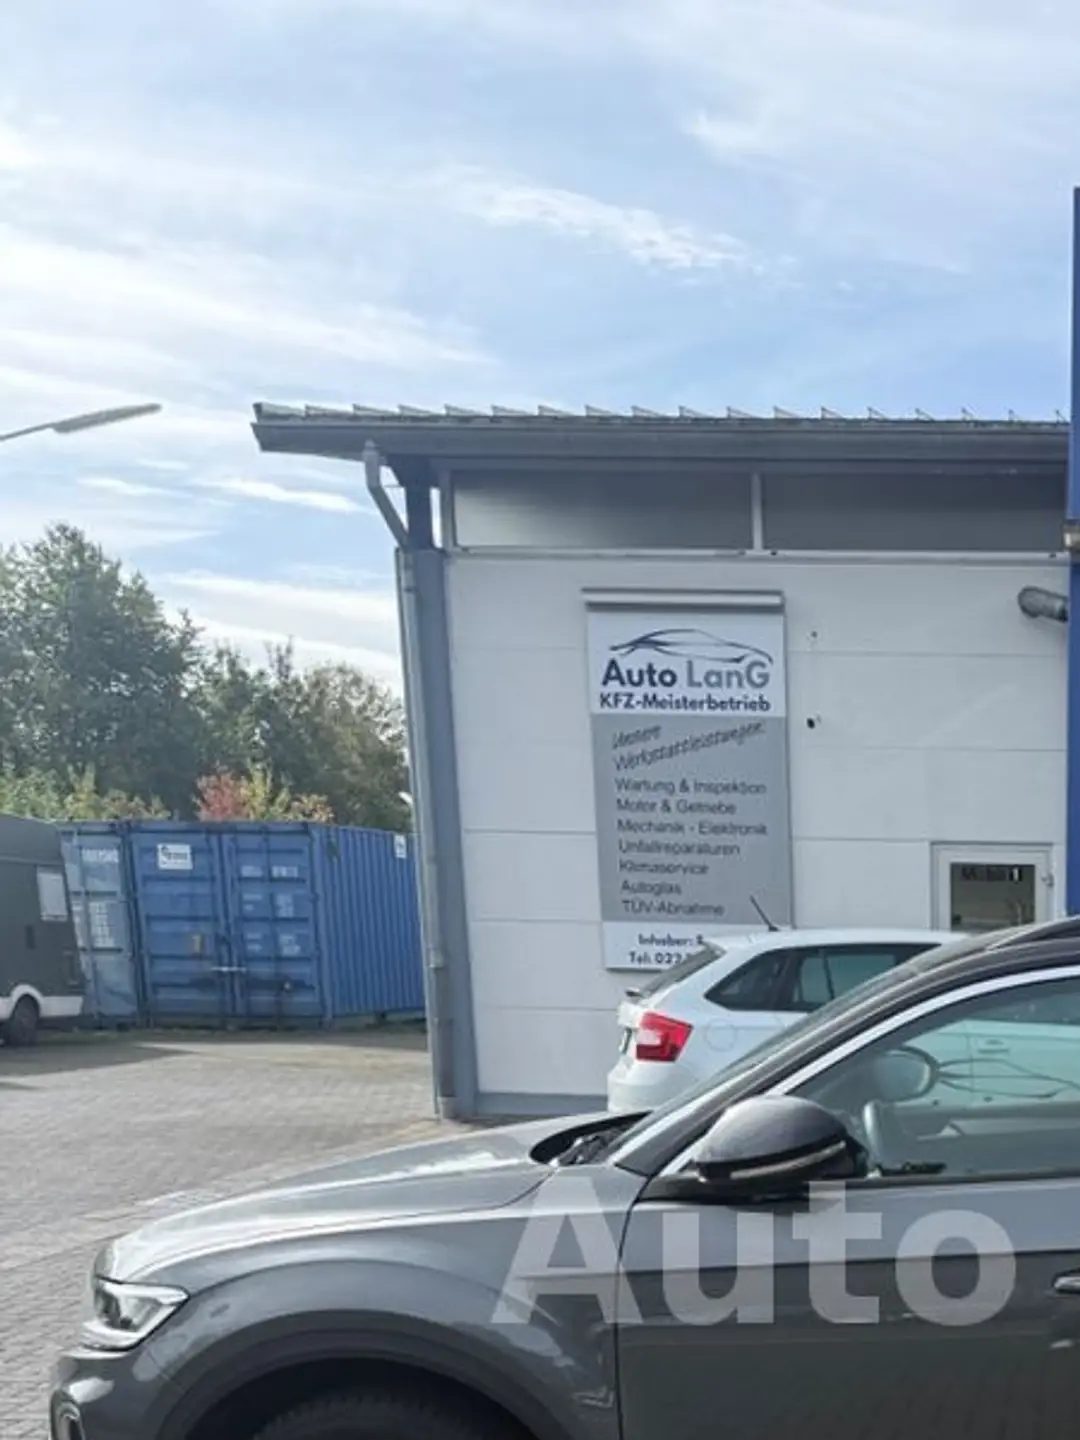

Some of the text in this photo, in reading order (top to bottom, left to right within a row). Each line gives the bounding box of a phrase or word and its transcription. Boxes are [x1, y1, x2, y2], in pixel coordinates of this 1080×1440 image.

[602, 657, 770, 689] Auto LanG
[600, 692, 771, 712] KFZ-Meisterbetrieb
[615, 778, 767, 796] Wartung & Inspektion
[616, 799, 737, 816] Motor & Getriebe
[617, 819, 685, 834] Mechanik
[698, 820, 768, 836] Elektronik
[618, 839, 741, 856] Unfallreparaturen
[619, 859, 710, 875] Klimaservice
[621, 879, 682, 897] Autoglas
[622, 899, 725, 917] TÜV-Abnahme
[638, 933, 694, 946] Inhaber:
